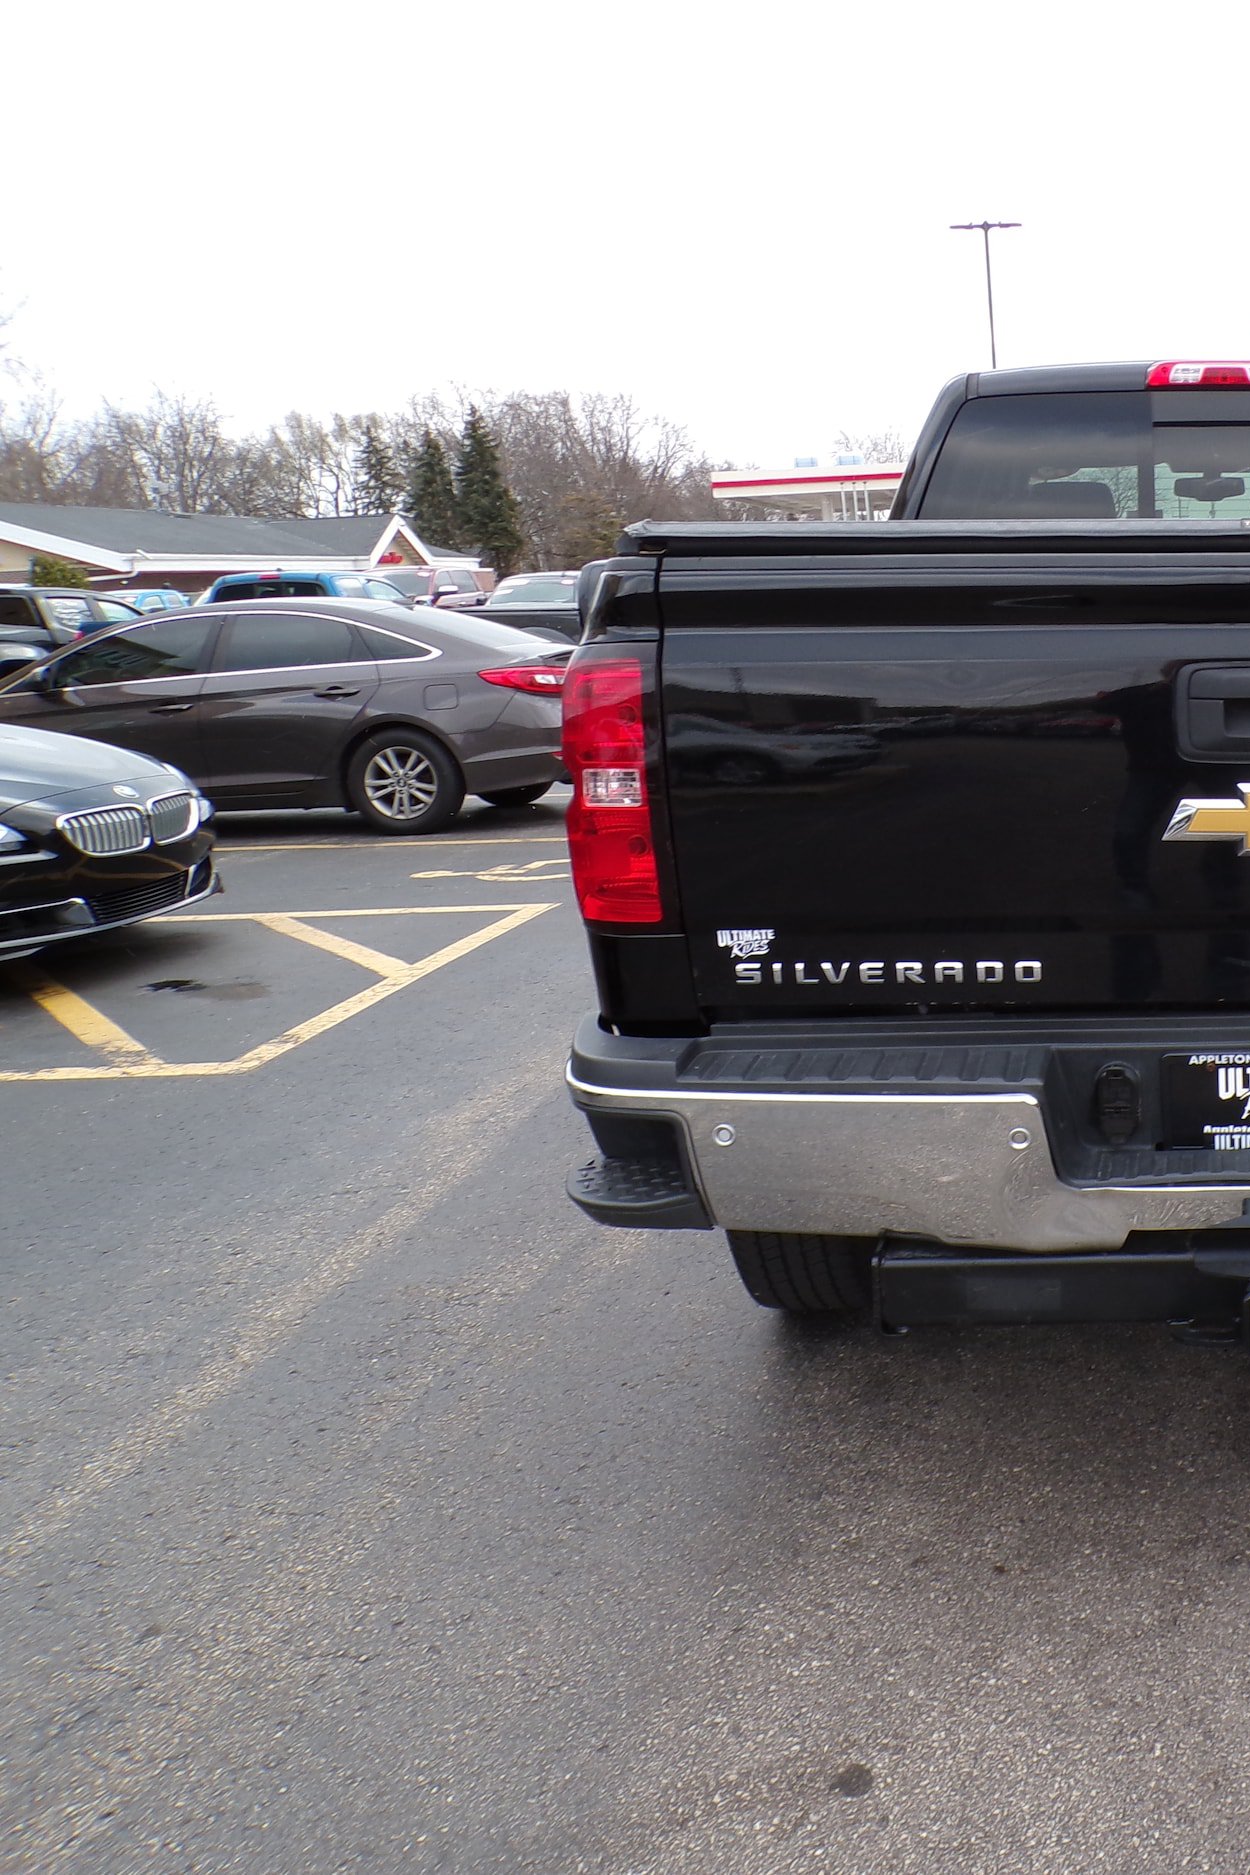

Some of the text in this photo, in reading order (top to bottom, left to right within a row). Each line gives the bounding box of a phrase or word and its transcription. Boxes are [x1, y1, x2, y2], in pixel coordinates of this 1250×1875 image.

[716, 928, 776, 948] ULTIMATE
[729, 939, 771, 960] RIDES
[735, 961, 1042, 985] SILVERADO
